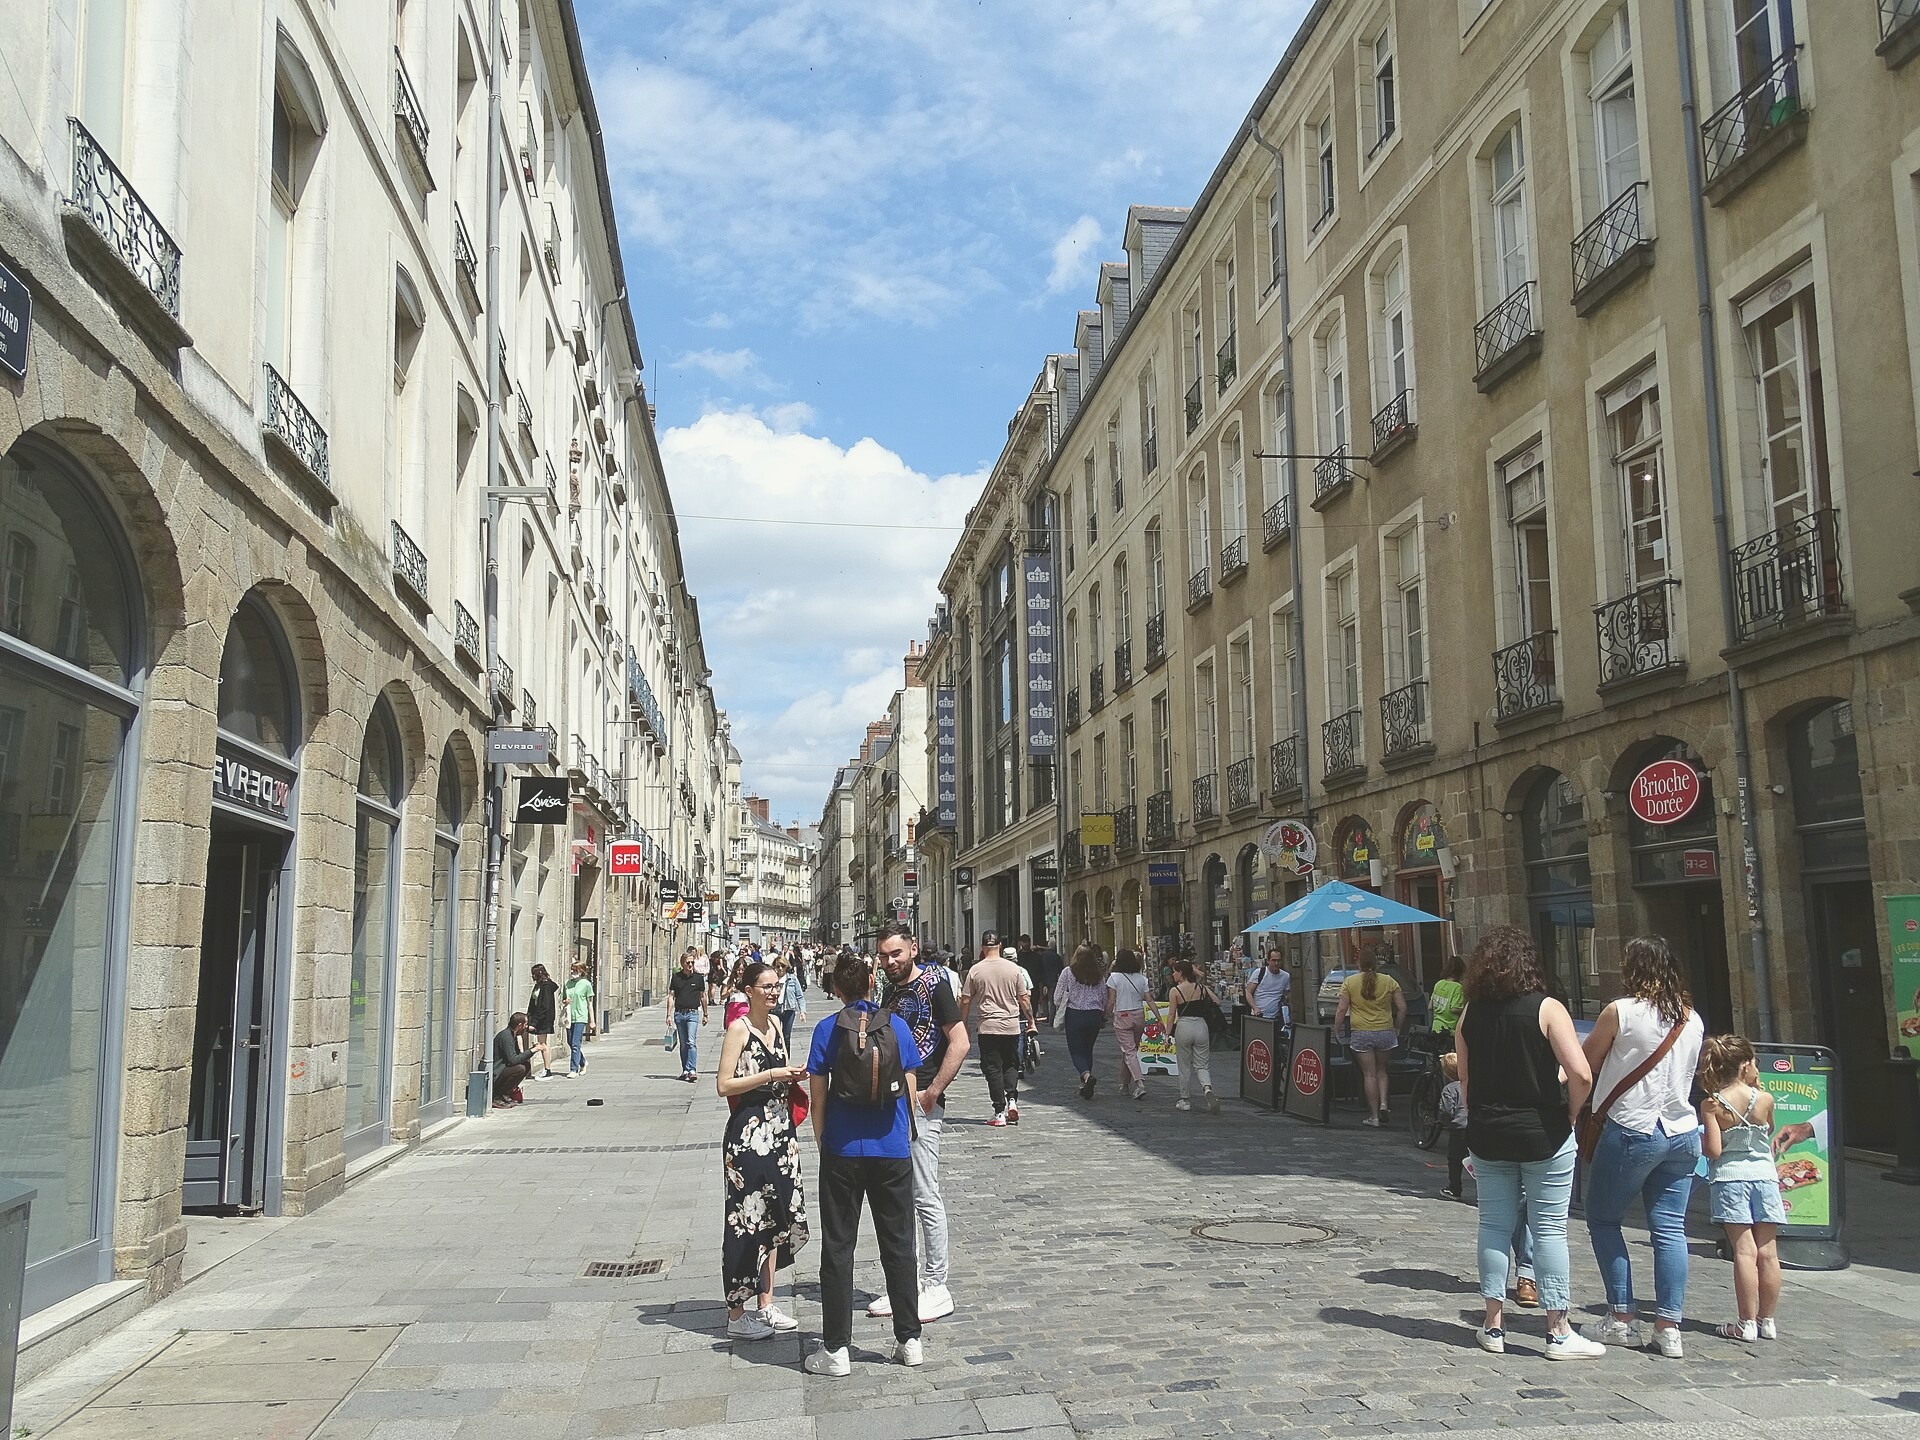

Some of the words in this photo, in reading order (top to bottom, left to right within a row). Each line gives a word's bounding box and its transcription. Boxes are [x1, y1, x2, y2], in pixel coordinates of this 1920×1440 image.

[212, 755, 274, 802] EVRED
[1639, 768, 1690, 798] Brioche
[520, 789, 566, 811] Lovisa
[1646, 792, 1684, 817] Dorée
[1082, 824, 1114, 833] BOCAGE
[615, 854, 640, 865] SFR
[1250, 1054, 1268, 1076] Dorée
[1296, 1064, 1318, 1088] Dorée
[1768, 1080, 1819, 1101] CUISINÉS
